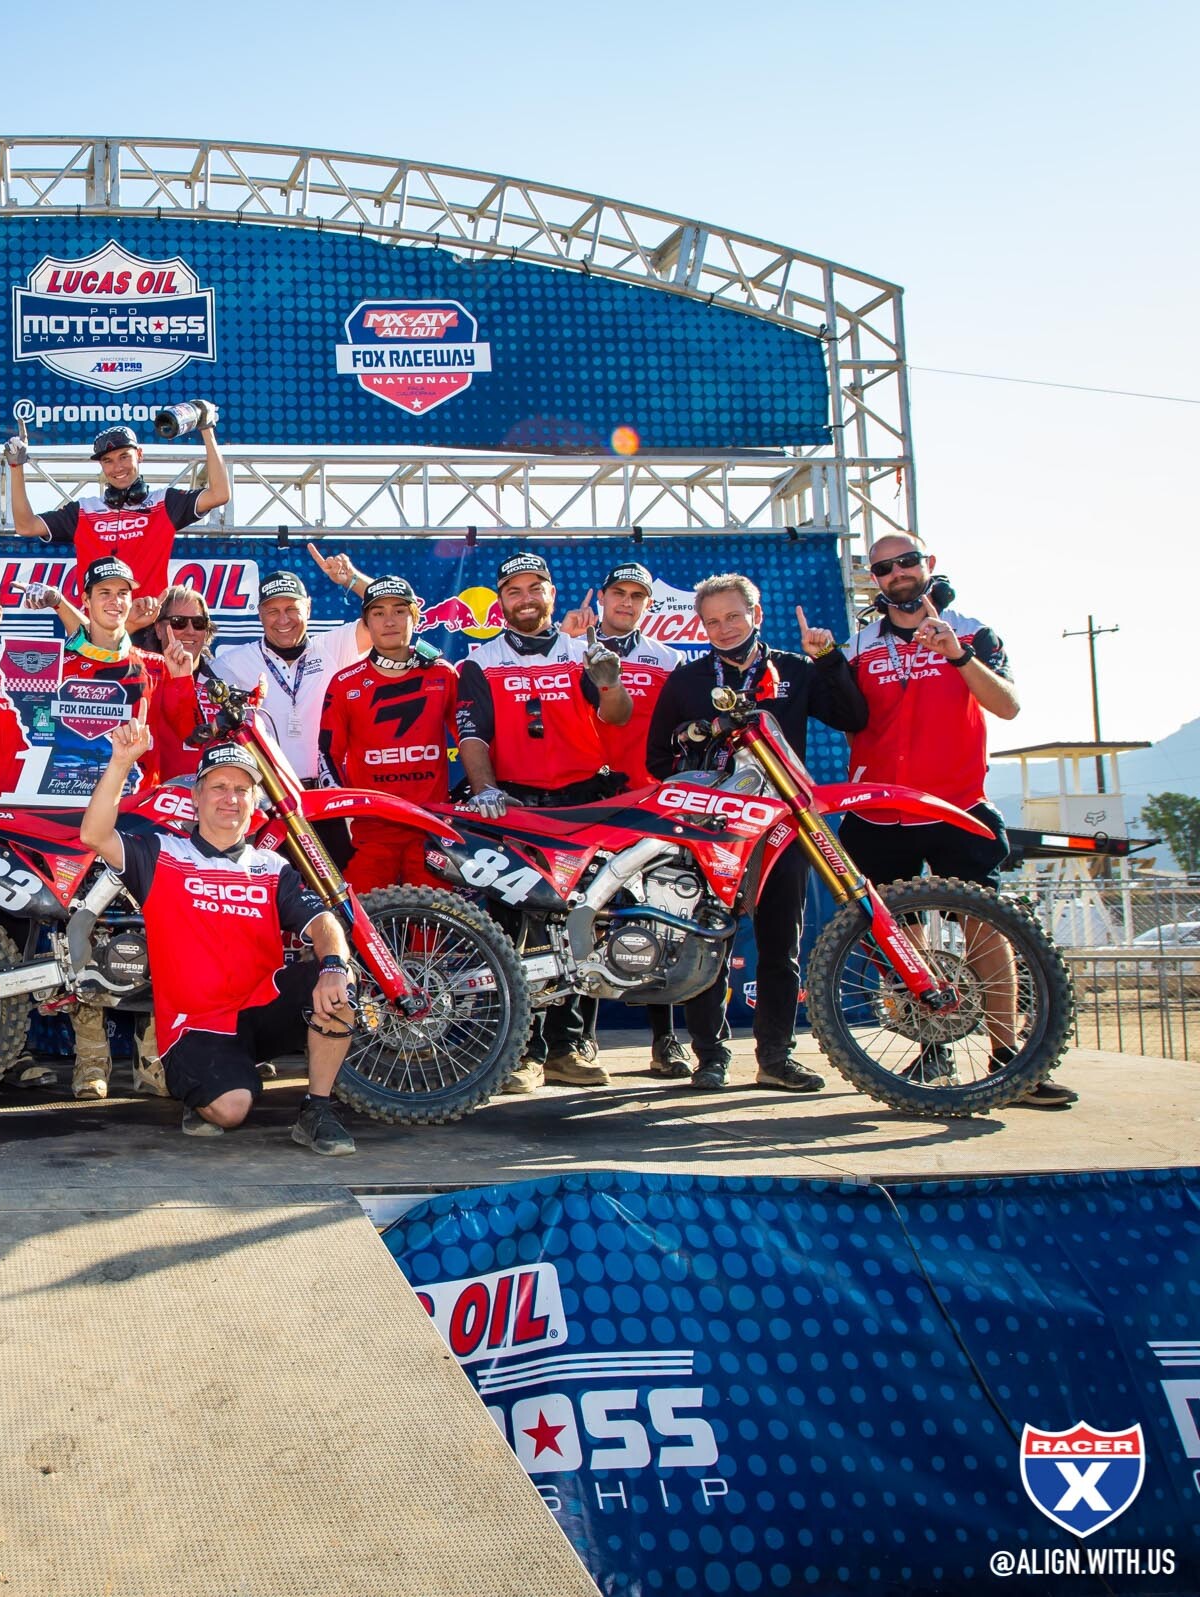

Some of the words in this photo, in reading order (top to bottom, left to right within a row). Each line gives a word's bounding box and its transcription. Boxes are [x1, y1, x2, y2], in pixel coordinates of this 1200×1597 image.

[46, 270, 132, 295] LUCAS
[136, 270, 177, 294] OIL
[90, 307, 138, 315] PRO
[23, 315, 206, 335] MOTOCROSS
[378, 327, 411, 338] ALL
[410, 326, 440, 337] OUT
[23, 334, 206, 343] CHAMPIONSHIP
[351, 349, 386, 368] FOX
[389, 348, 475, 368] RACEWAY
[90, 362, 125, 373] AMA
[372, 375, 459, 385] NATIONAL
[93, 516, 150, 533] GEICO
[99, 530, 145, 542] HONDA
[501, 556, 542, 573] GEICO
[506, 564, 540, 575] HONDA
[613, 567, 650, 579] GEICO
[261, 579, 298, 594] GEICO
[266, 586, 297, 596] HONDA
[367, 580, 407, 594] GEICO
[373, 588, 405, 597] HONDA
[375, 654, 421, 671] 100%
[868, 650, 949, 675] GEICO
[338, 661, 368, 682] GEICO
[878, 668, 942, 685] HONDA
[503, 672, 572, 691] GEICO
[74, 692, 92, 700] ALL
[91, 693, 108, 701] OUT
[59, 703, 76, 714] FOX
[78, 704, 124, 717] RACEWAY
[68, 718, 115, 726] NATIONAL
[208, 747, 254, 763] GEICO
[364, 744, 440, 765] GEICO
[48, 778, 72, 790] First
[373, 770, 436, 783] HONDA
[657, 788, 775, 826] GEICO
[296, 832, 333, 879] SHOWA
[809, 830, 850, 876] SHOWA
[708, 861, 740, 872] HONDA
[459, 848, 543, 906] 84
[184, 877, 269, 904] GEICO
[192, 898, 263, 919] HONDA
[429, 901, 483, 932] DUNLOP
[366, 942, 394, 981] WISECO
[369, 932, 400, 976] DUNLOP
[615, 954, 652, 962] HINSON
[886, 935, 920, 975] WISECO
[111, 962, 144, 971] HINSON
[467, 976, 496, 988] DID
[448, 1270, 551, 1358] OIL
